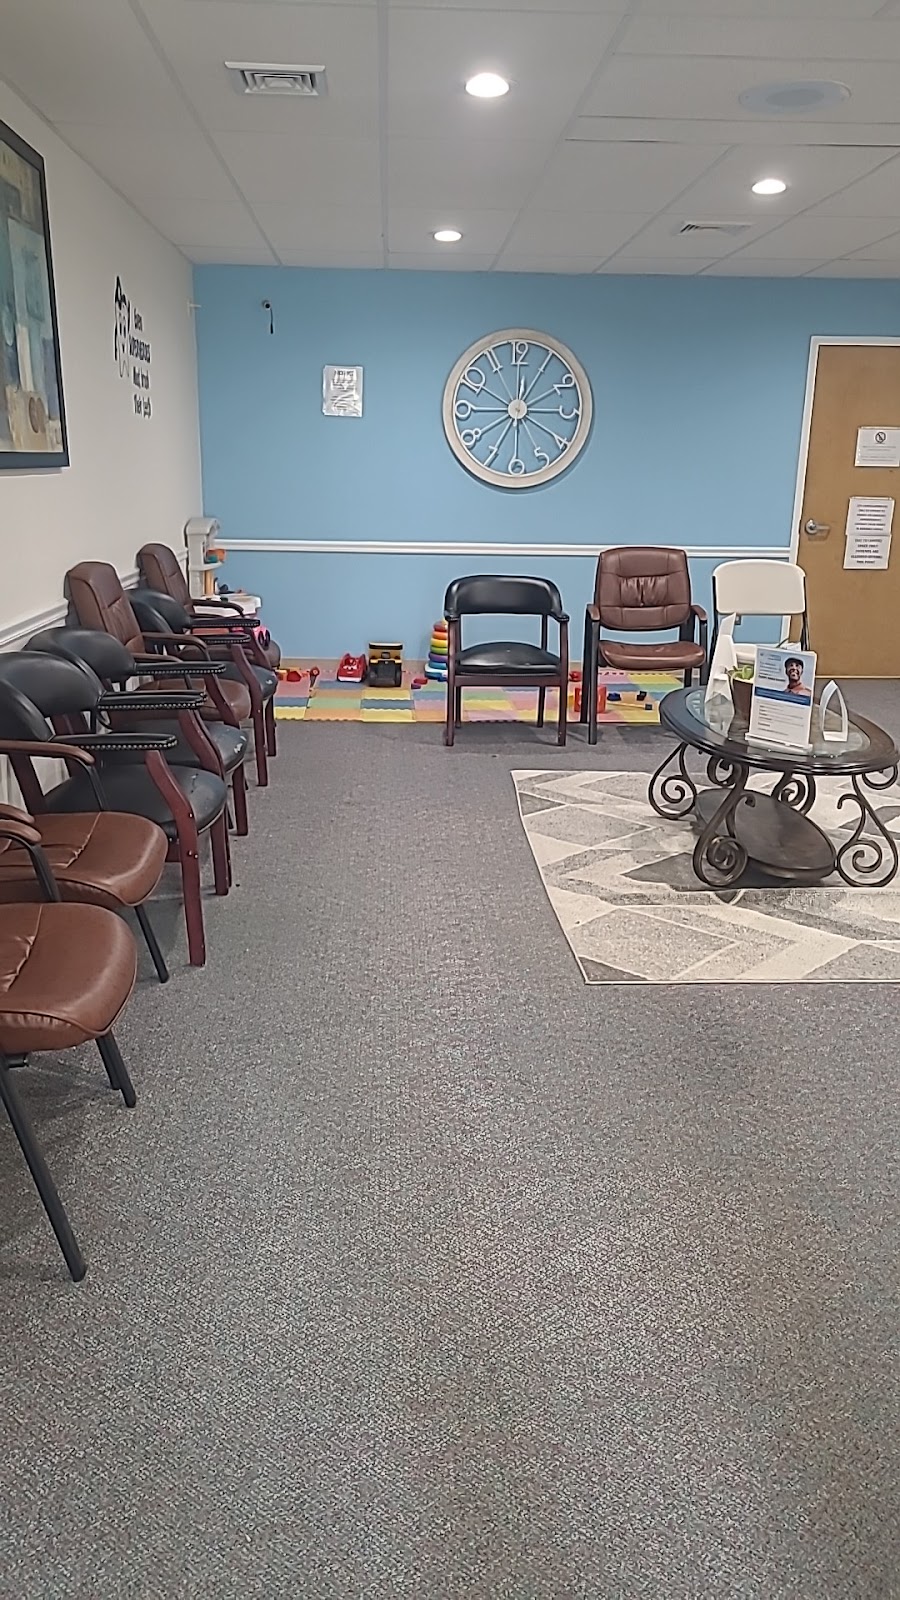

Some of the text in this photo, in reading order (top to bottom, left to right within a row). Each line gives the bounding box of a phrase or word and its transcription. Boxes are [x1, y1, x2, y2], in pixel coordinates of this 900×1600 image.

[483, 348, 503, 373] 11
[511, 341, 528, 366] 12
[460, 367, 486, 395] 10
[552, 373, 575, 396] 2
[455, 400, 476, 418] 9
[559, 404, 580, 419] 3
[461, 428, 481, 446] 8
[554, 435, 573, 449] 4
[483, 445, 498, 467] 7
[508, 453, 525, 476] 6
[534, 446, 550, 469] 5
